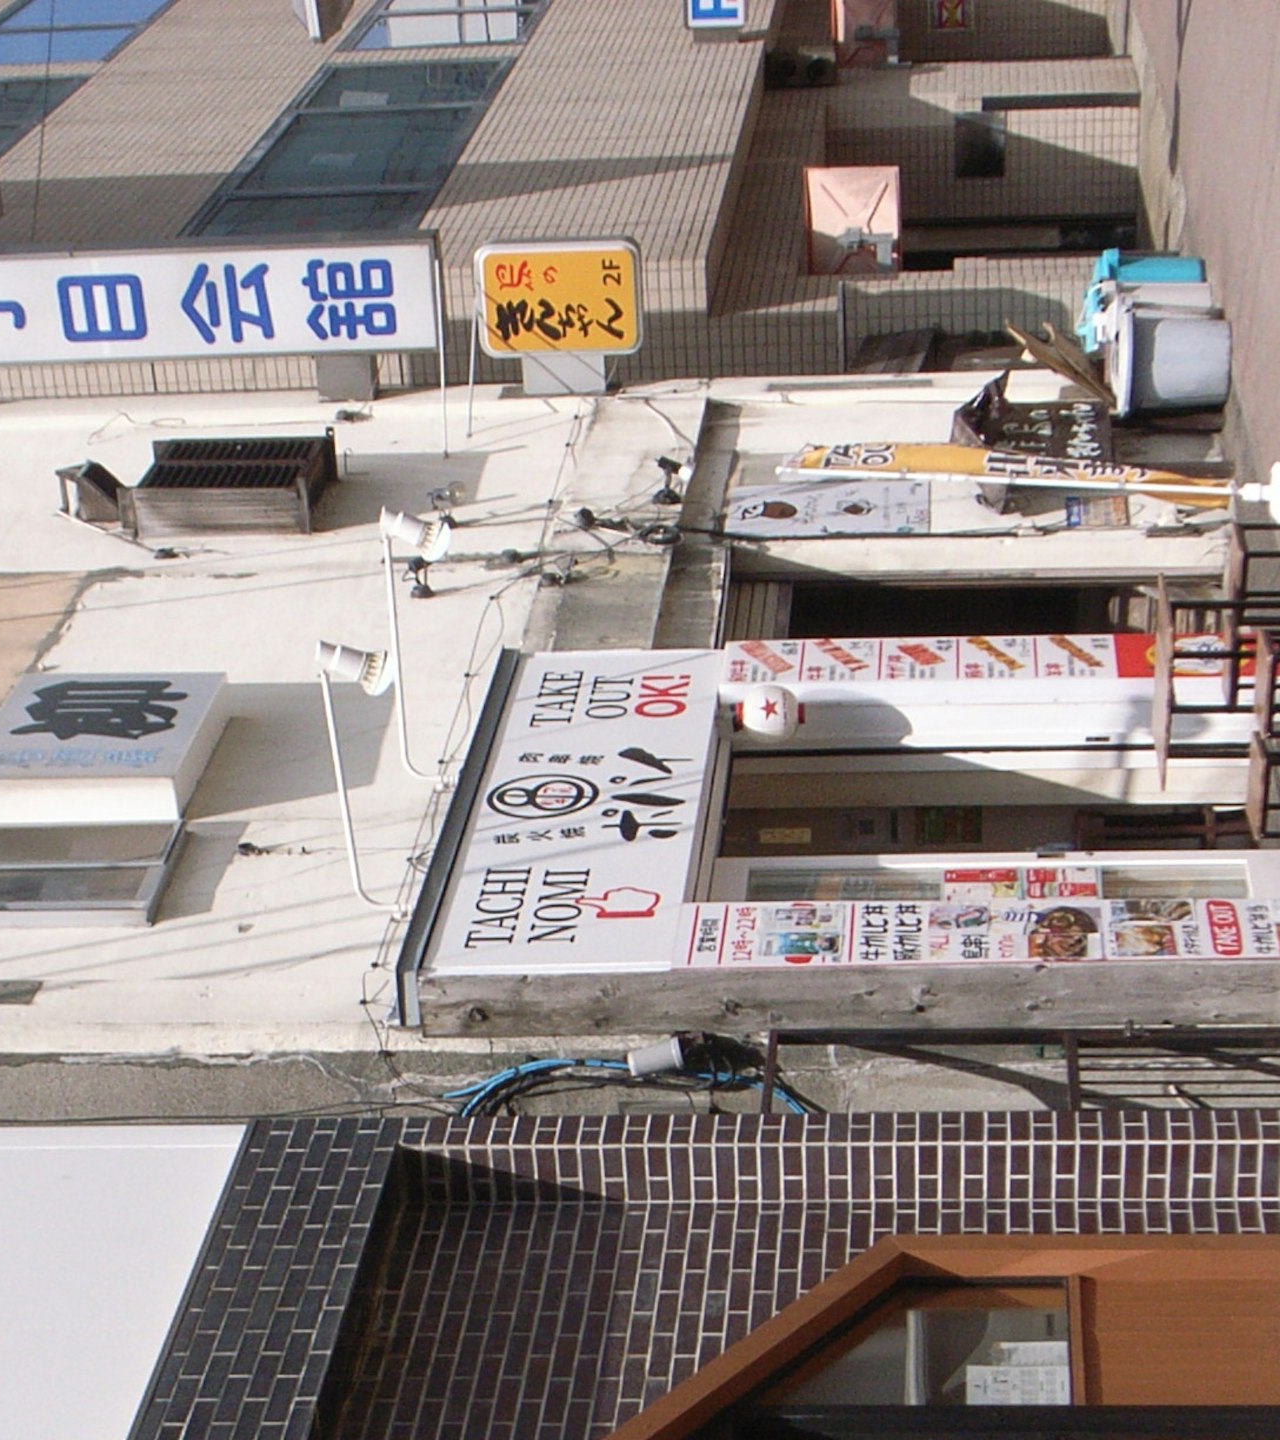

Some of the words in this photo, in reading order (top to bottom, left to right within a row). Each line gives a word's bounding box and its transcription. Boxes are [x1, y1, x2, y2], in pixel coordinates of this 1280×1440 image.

[601, 257, 622, 287] 2F
[494, 297, 625, 342] きんちゃん
[528, 670, 584, 727] TAKE
[585, 675, 634, 720] OUT
[633, 674, 691, 719] OK!
[599, 747, 695, 842] ポパイ
[463, 866, 533, 949] TACHI
[527, 868, 591, 944] NOMI
[1208, 903, 1236, 924] OUT
[858, 903, 889, 961] 牛カルビ丼
[1211, 925, 1241, 953] TAKE
